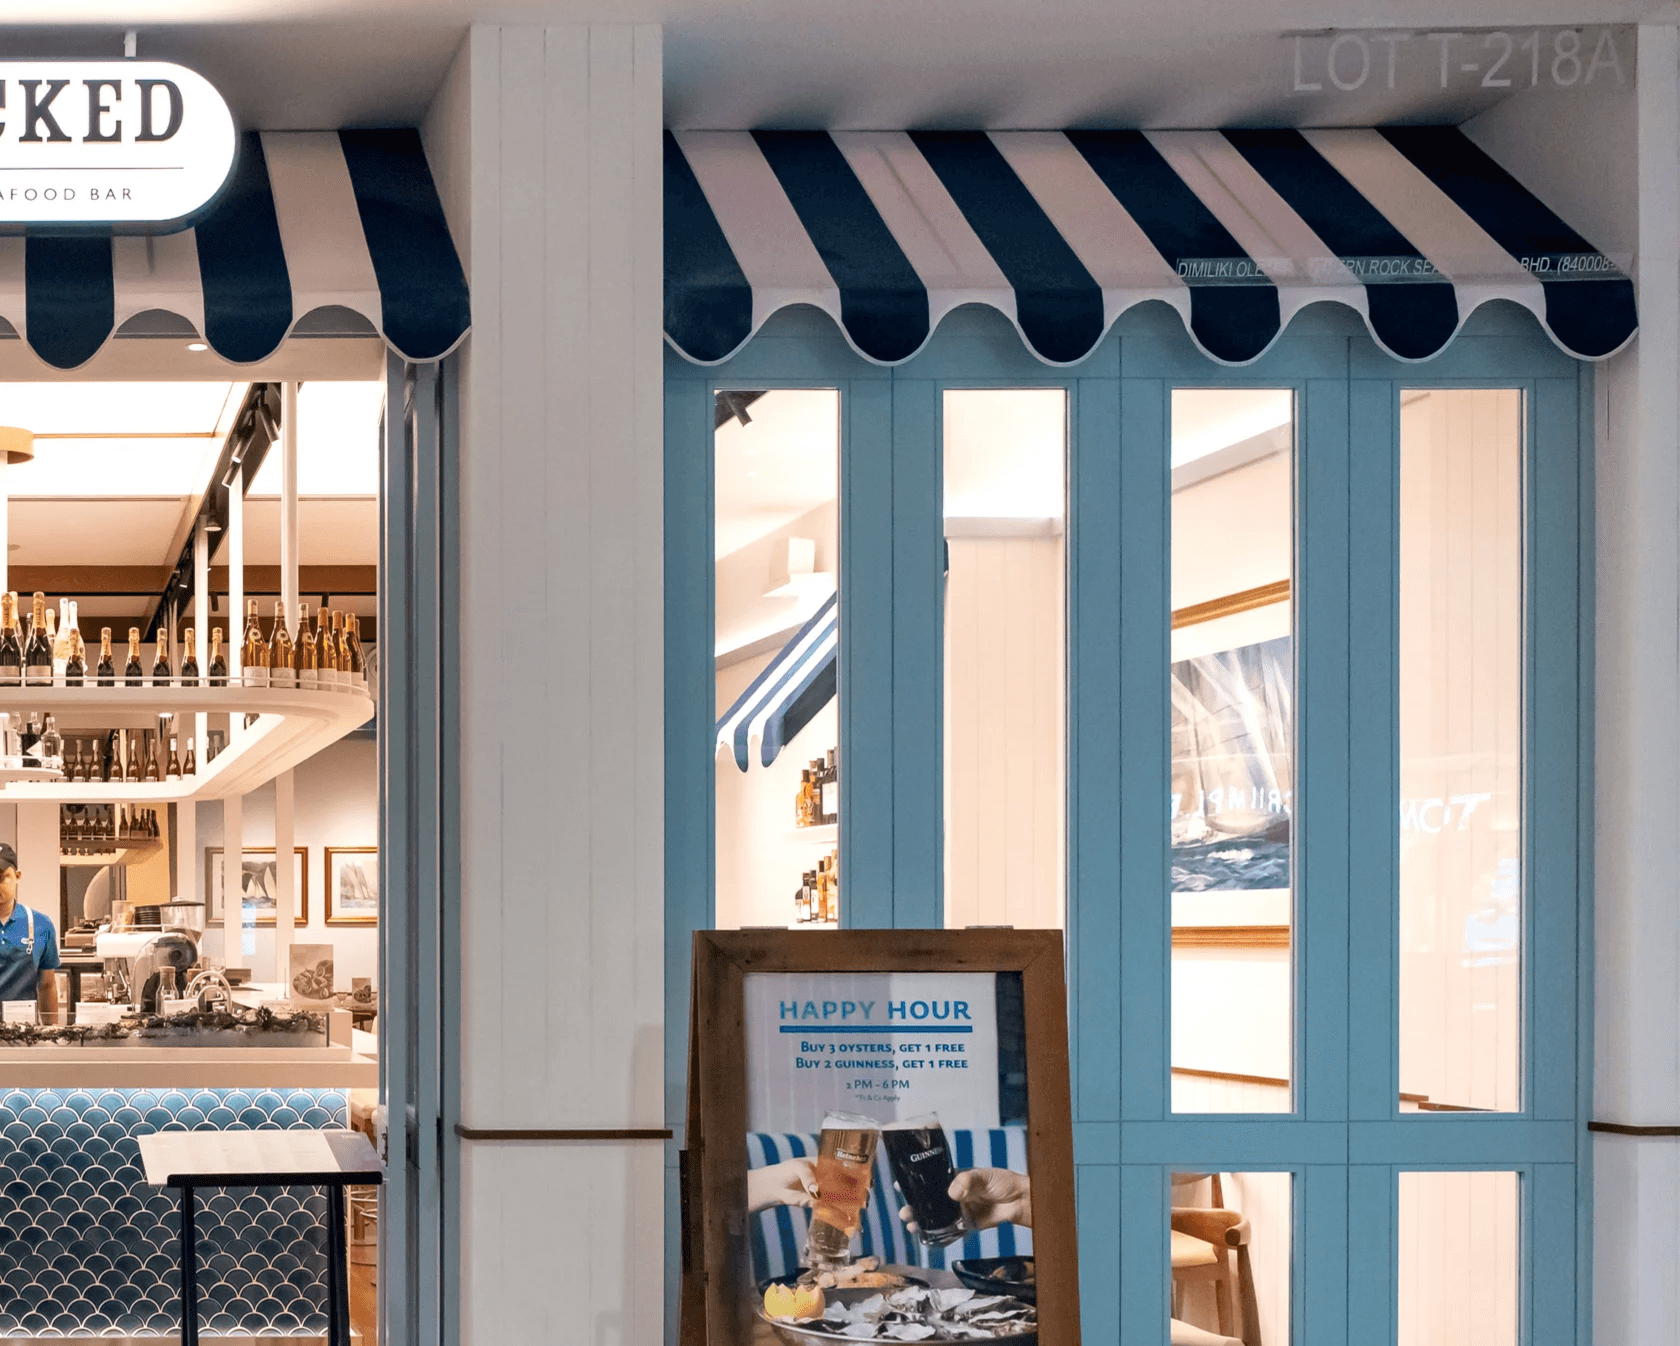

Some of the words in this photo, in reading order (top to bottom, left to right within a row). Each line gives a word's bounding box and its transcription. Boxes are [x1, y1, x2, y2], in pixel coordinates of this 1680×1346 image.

[1294, 34, 1410, 91] LOT
[1427, 29, 1626, 88] T-218A
[90, 187, 134, 201] BAR
[1178, 262, 1232, 277] DIMILIKI
[1369, 259, 1409, 275] ROCK
[779, 1000, 875, 1020] HAPPY
[888, 1000, 972, 1020] HOUR
[829, 1044, 836, 1055] 3
[839, 1043, 896, 1055] OYSTERS,
[899, 1043, 922, 1053] GET
[925, 1043, 931, 1053] 1
[935, 1043, 965, 1053] FREE
[824, 1060, 832, 1069] 2
[835, 1059, 899, 1071] GUINNESS,
[902, 1060, 925, 1069] GET
[928, 1060, 934, 1069] 1
[938, 1060, 968, 1069] FREE
[854, 1080, 873, 1089] PM
[882, 1080, 889, 1089] 6
[891, 1080, 910, 1089] PM
